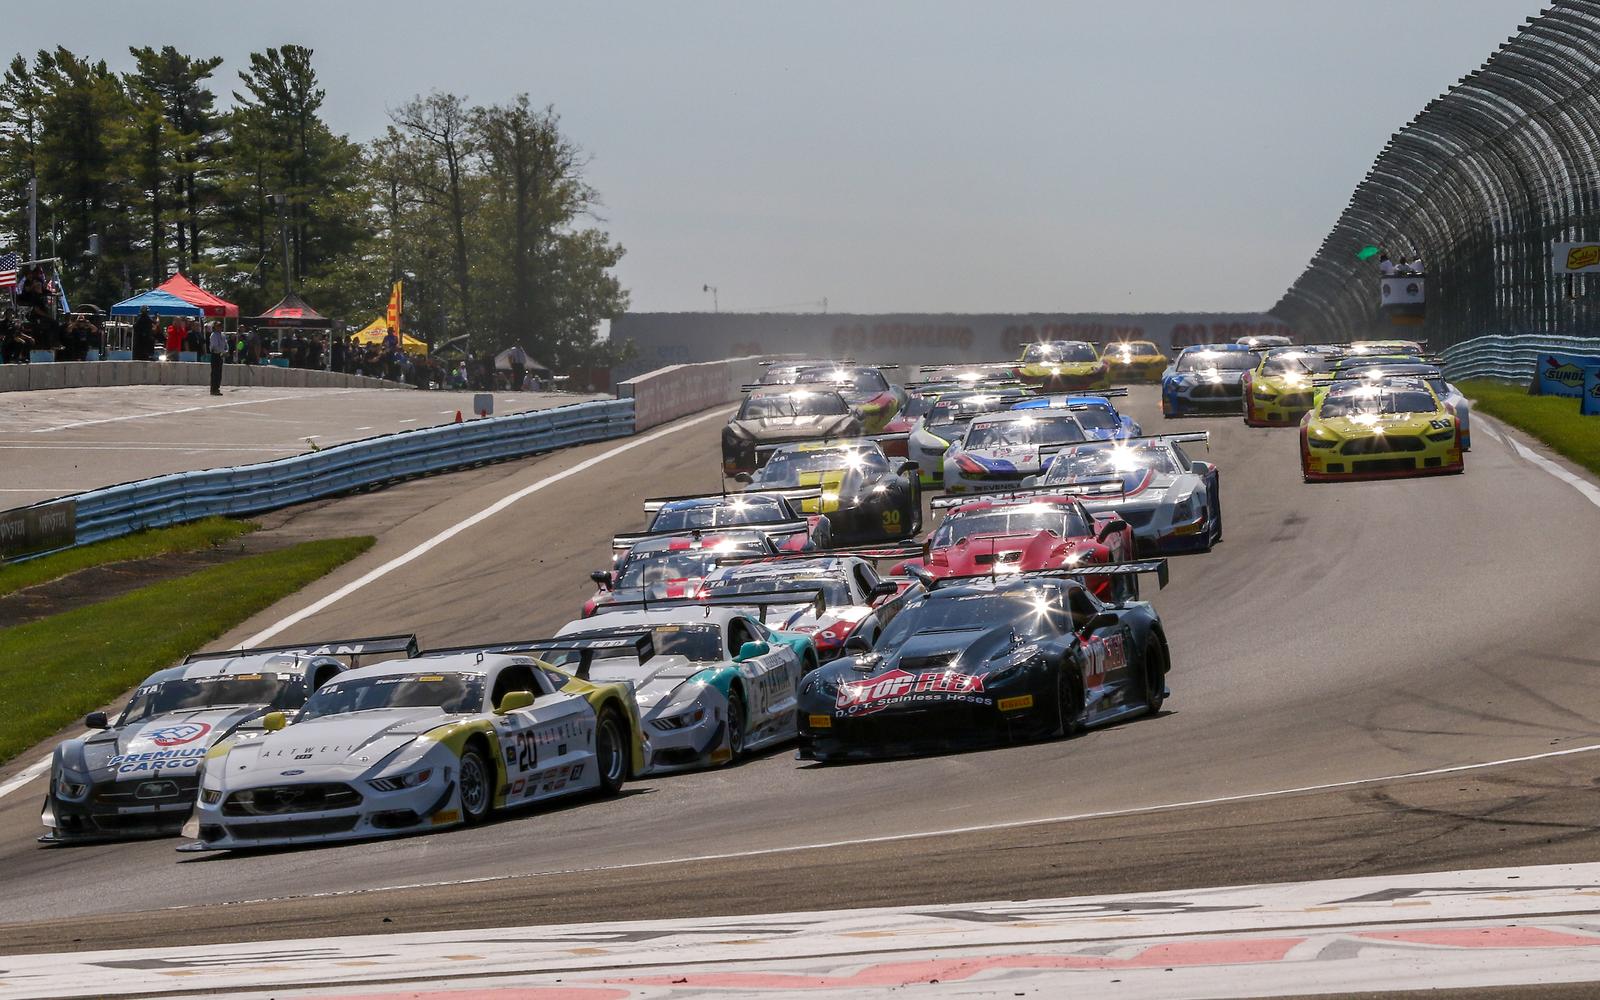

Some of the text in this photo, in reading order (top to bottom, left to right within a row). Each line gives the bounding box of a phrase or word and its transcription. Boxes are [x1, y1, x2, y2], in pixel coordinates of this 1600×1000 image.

[882, 510, 900, 524] 30
[915, 672, 991, 693] FLEX
[877, 693, 942, 706] Stainless
[947, 694, 993, 706] Hoses
[263, 745, 352, 758] ALTWELL
[517, 730, 537, 772] 20
[120, 758, 199, 773] CARGO
